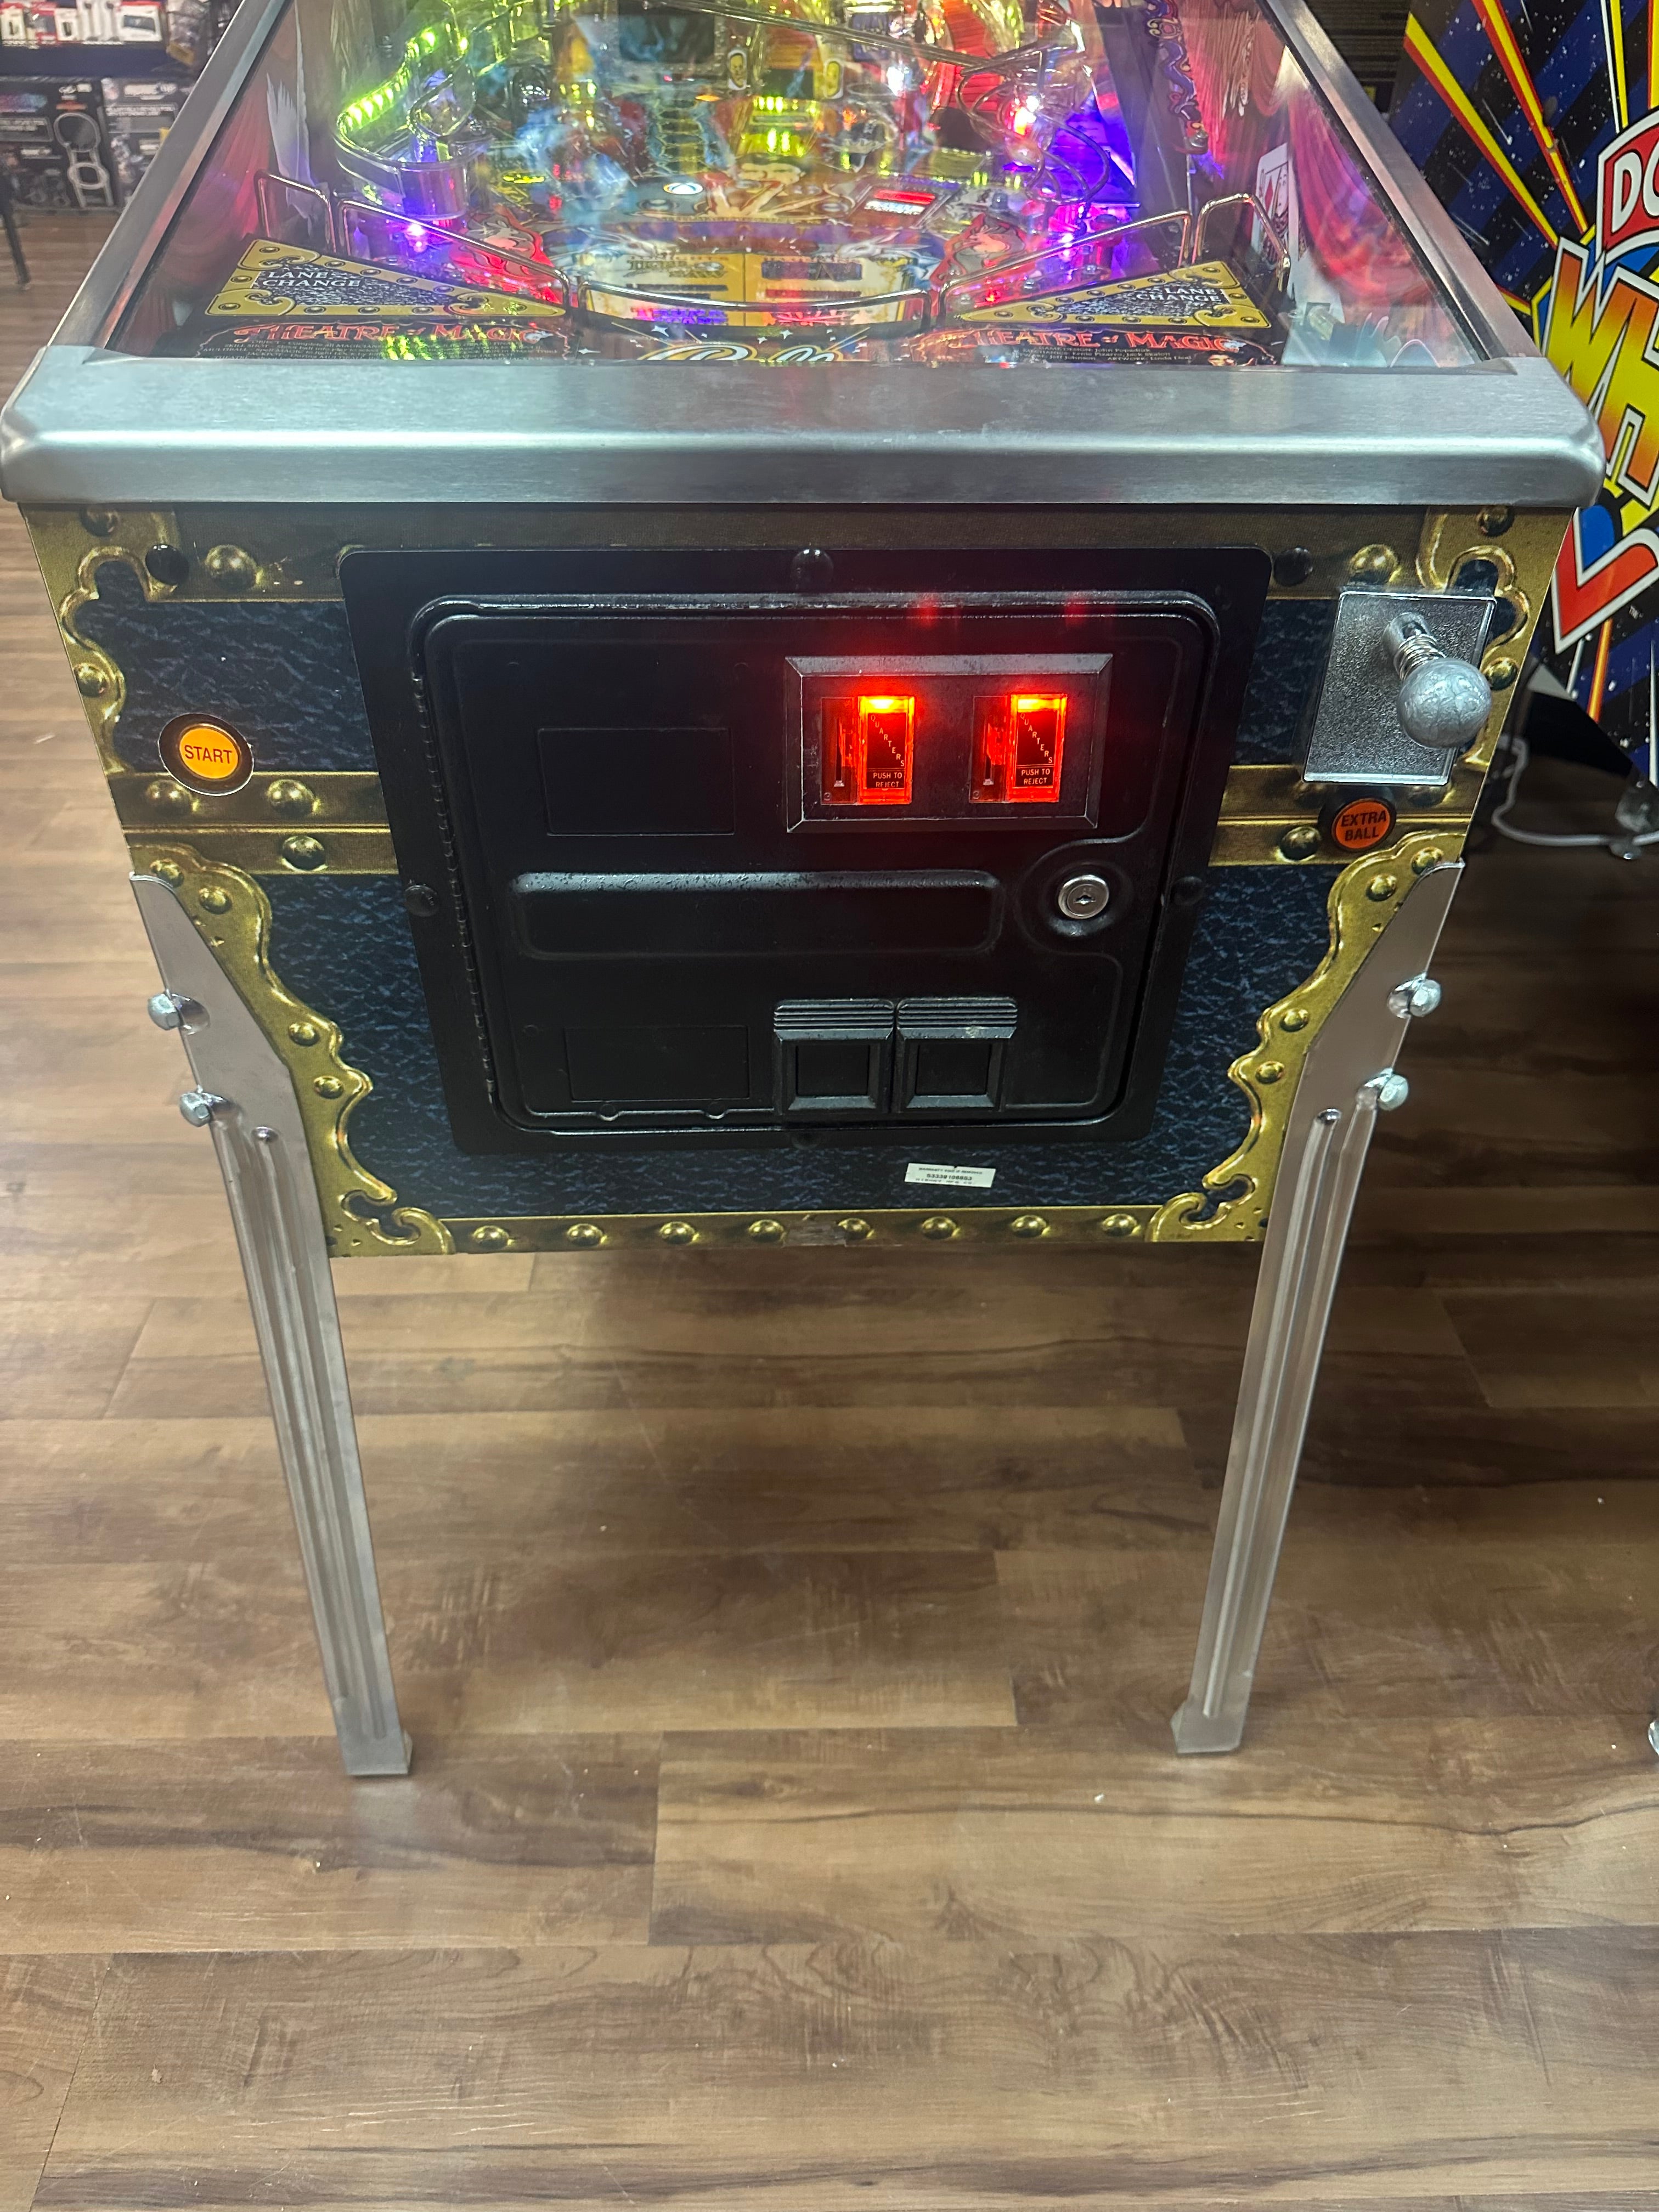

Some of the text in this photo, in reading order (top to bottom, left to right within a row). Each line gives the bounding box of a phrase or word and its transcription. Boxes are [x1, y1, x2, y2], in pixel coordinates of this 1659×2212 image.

[233, 324, 399, 343] THEATRE
[434, 324, 540, 344] MAGIC
[947, 329, 1100, 349] THEATRE
[1126, 332, 1239, 353] MAGIC
[871, 714, 905, 767] QUARTERS
[1020, 712, 1053, 764] QUARTERS
[184, 744, 233, 764] START
[1023, 777, 1047, 785] REJECT
[1341, 810, 1387, 827] EXTRA
[1344, 826, 1379, 842] BALL
